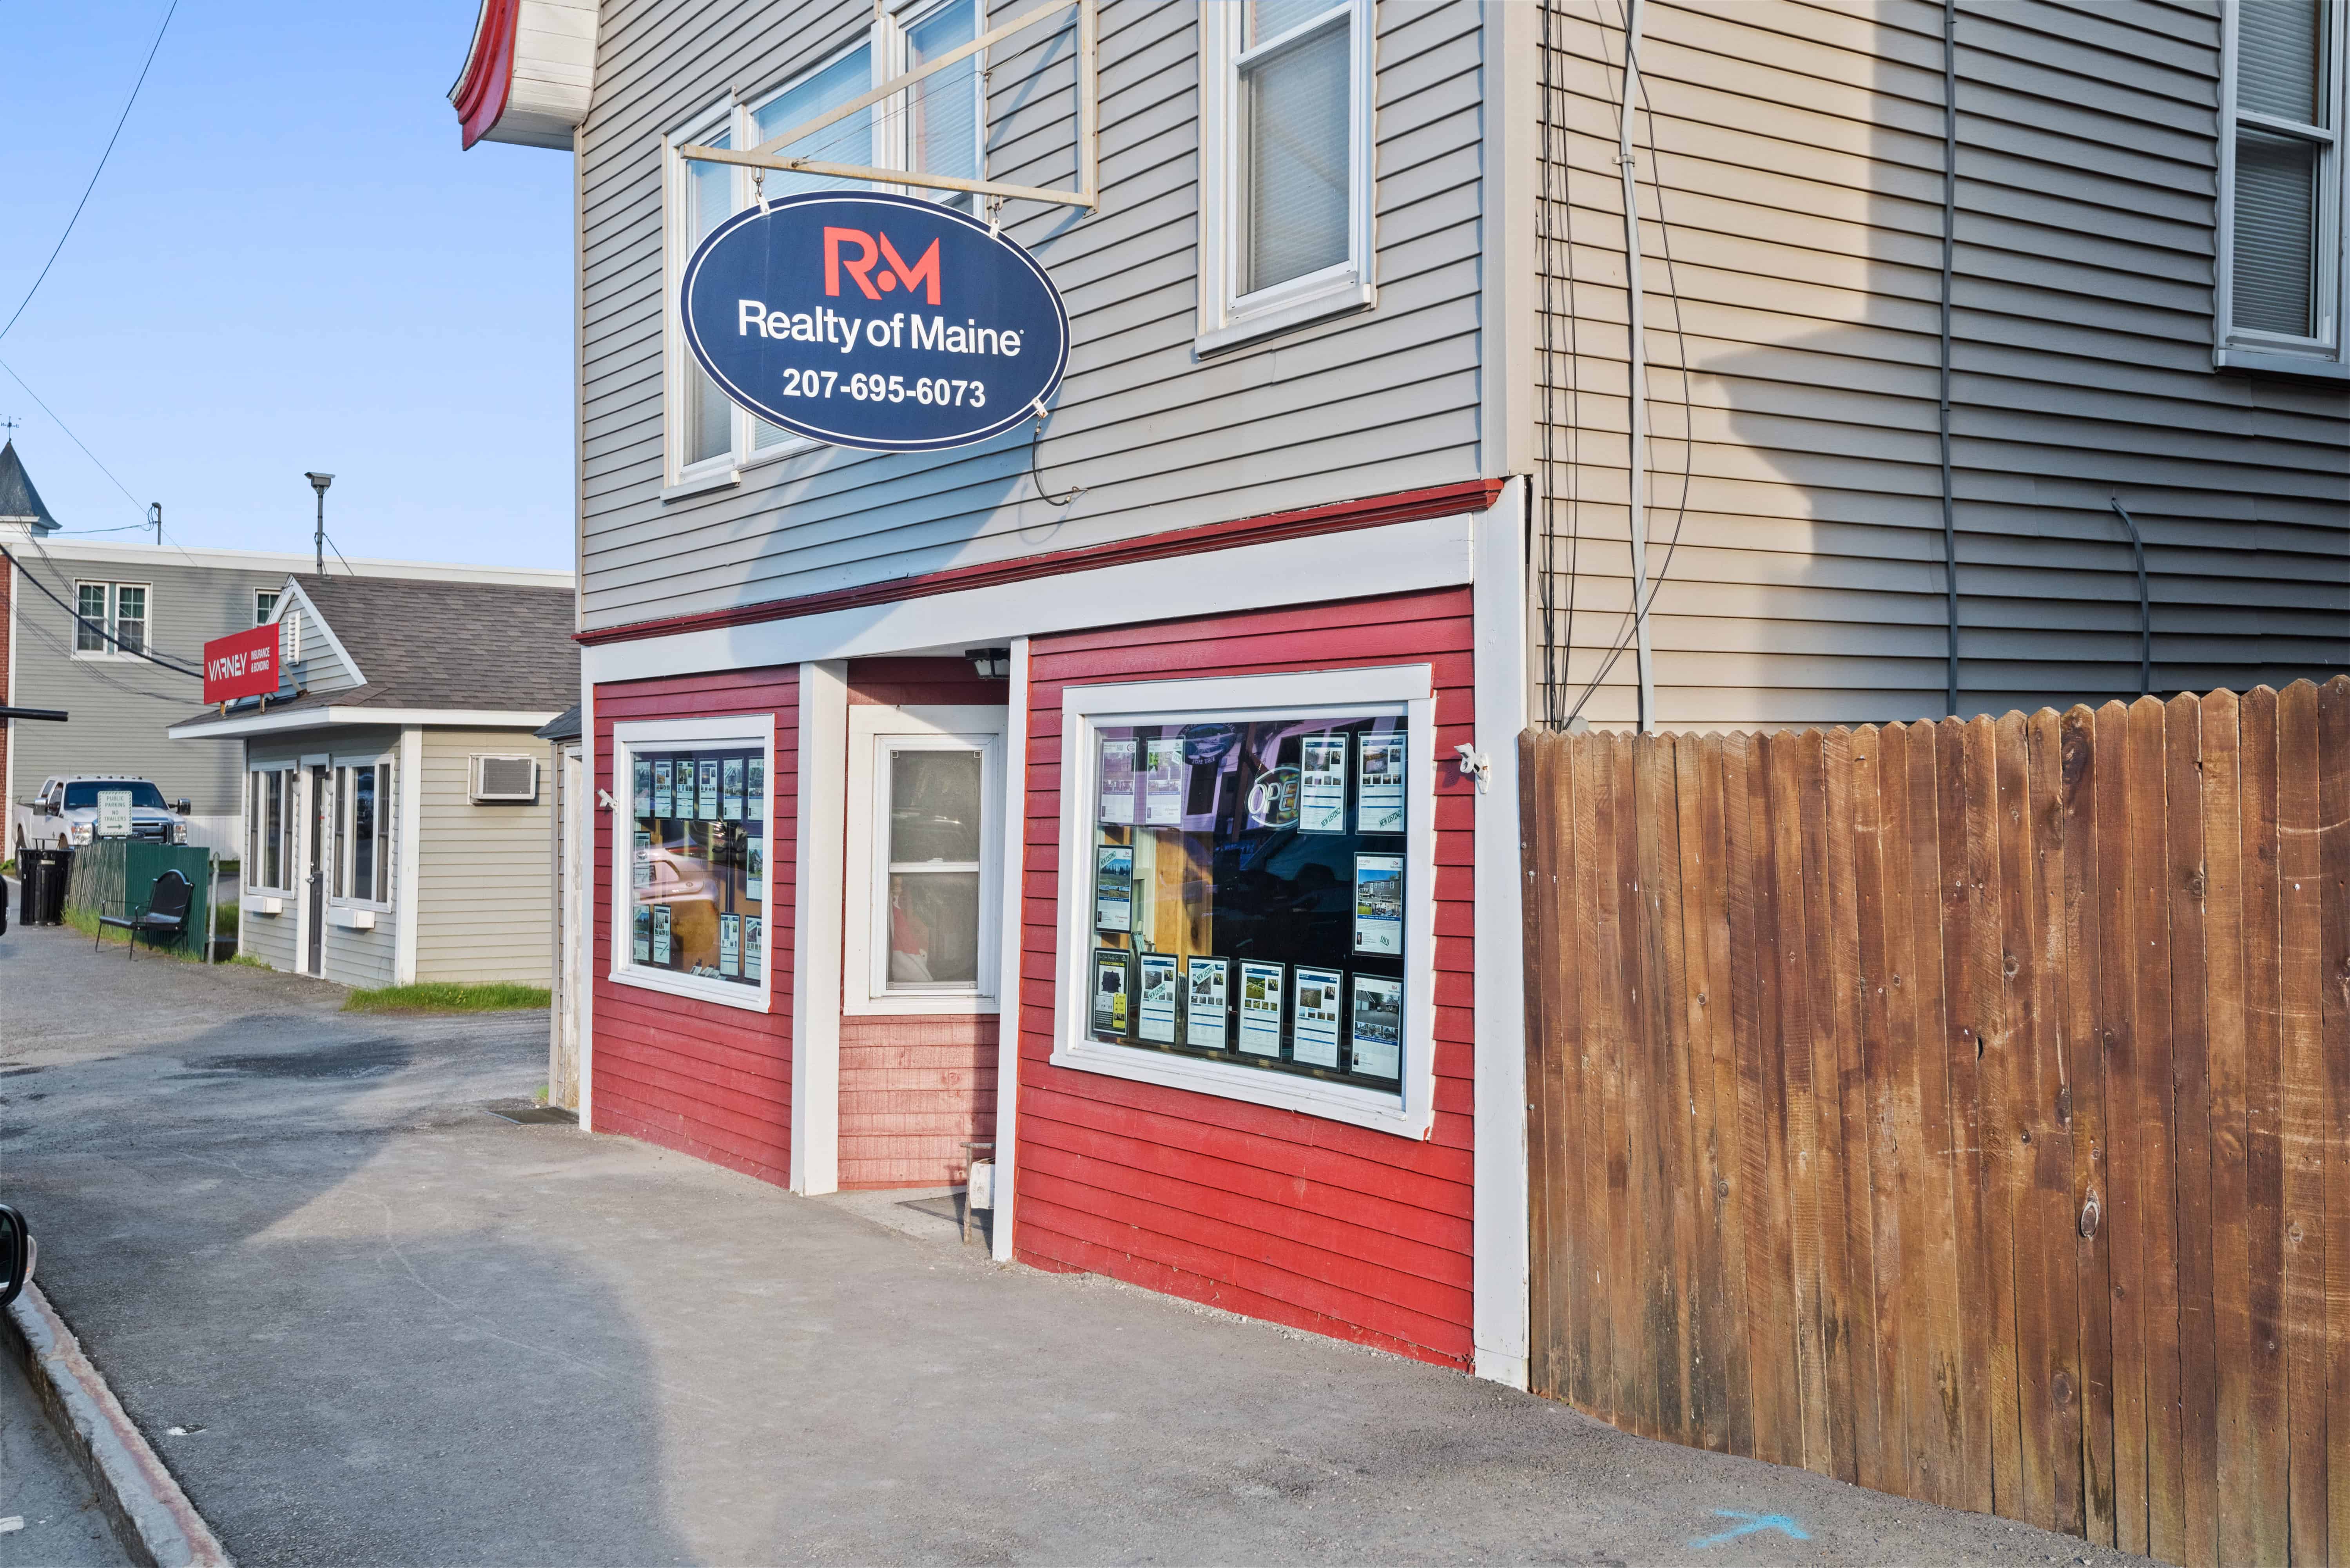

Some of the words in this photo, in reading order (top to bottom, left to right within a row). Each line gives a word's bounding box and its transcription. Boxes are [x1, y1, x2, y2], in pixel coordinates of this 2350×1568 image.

[739, 299, 861, 353] Realty
[867, 313, 904, 348] of
[911, 314, 1021, 356] Maine
[783, 368, 986, 408] 207-695-6073
[251, 647, 270, 660] INSURANCE
[208, 652, 247, 682] VARNEY
[254, 660, 269, 673] BONDING
[1380, 935, 1389, 946] SOLD
